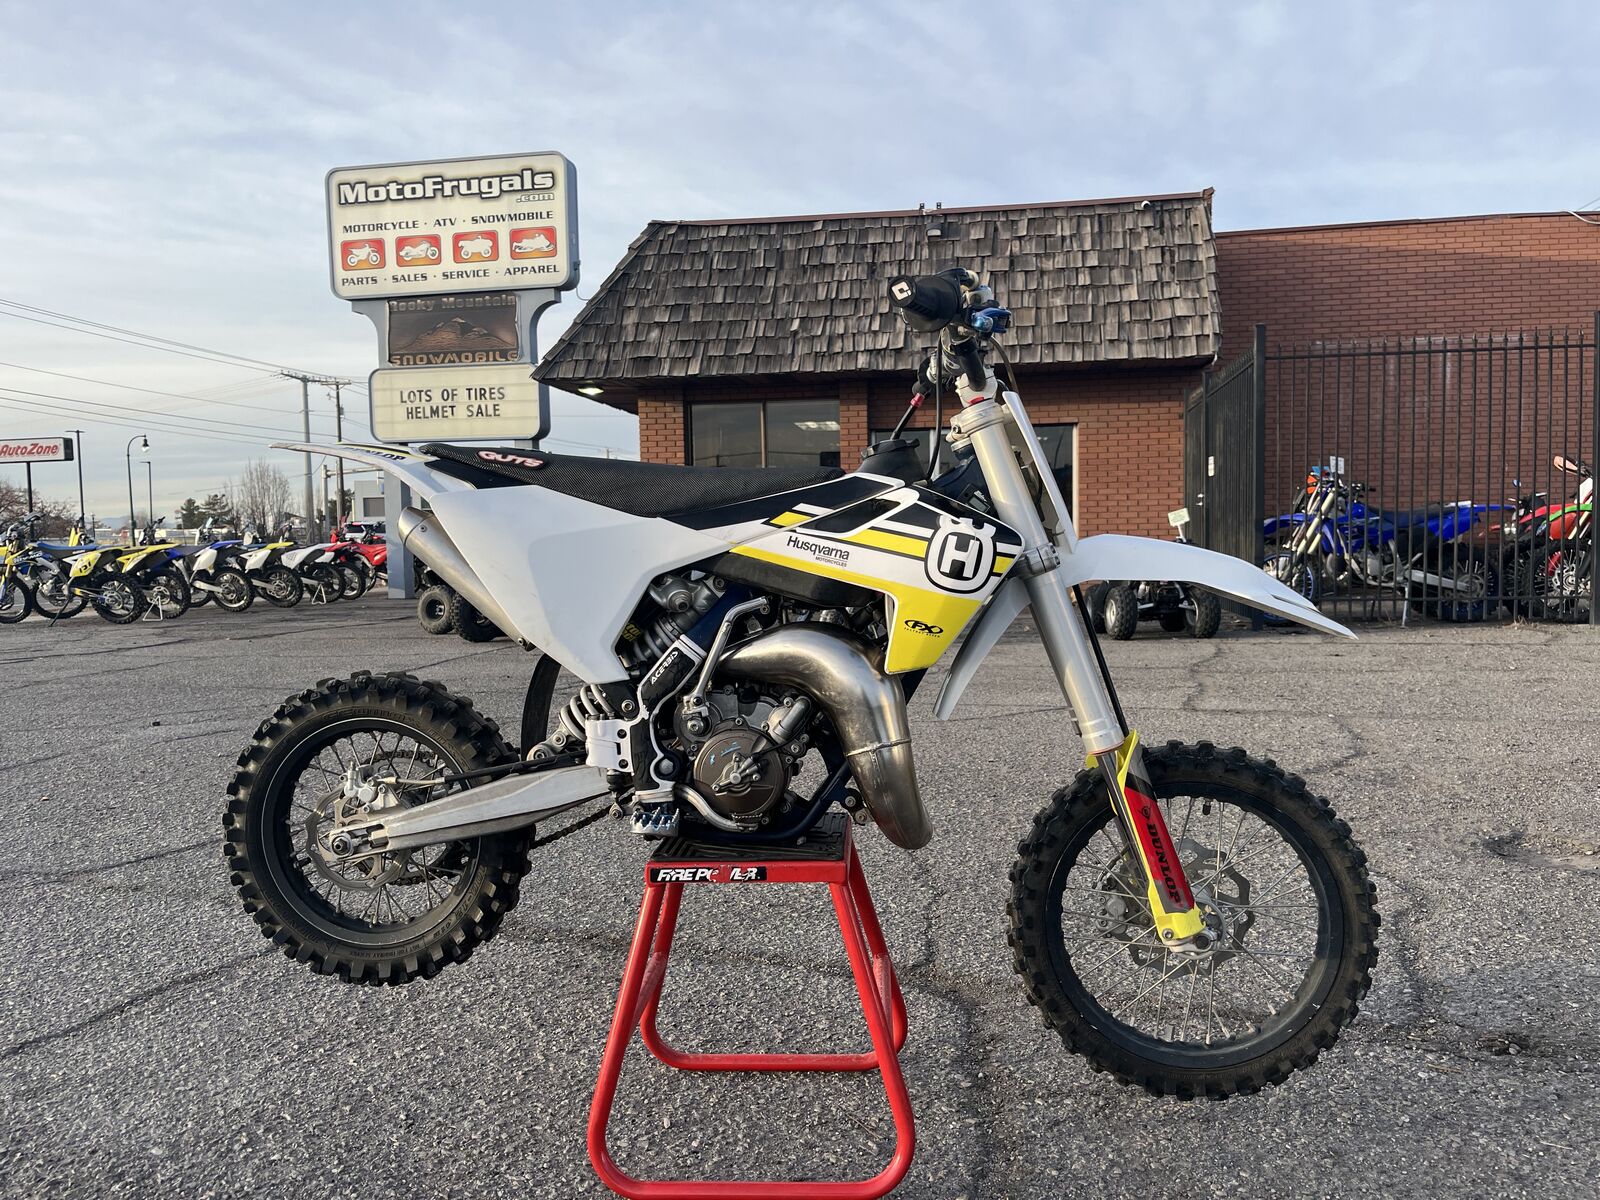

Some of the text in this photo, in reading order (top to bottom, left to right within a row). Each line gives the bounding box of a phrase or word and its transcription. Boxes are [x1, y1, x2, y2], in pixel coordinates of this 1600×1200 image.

[338, 168, 555, 205] MotoFrugals
[517, 192, 555, 203] .com
[342, 210, 554, 234] MOTORCYCLE ATV SNOWMOBILE
[341, 264, 560, 287] PARTS SALES SERVICE APPAREL
[389, 294, 516, 312] Rocky Mountain
[391, 350, 518, 367] SNOWMOBILE
[400, 386, 505, 404] LOTS OF TIRES
[406, 403, 500, 420] HELMET SALE
[0, 443, 59, 457] AutoZone
[478, 450, 544, 467] GUTS
[786, 535, 850, 561] Husqvarna
[815, 556, 848, 568] MOTORCYCLES
[651, 651, 678, 685] ACERBIS
[1147, 823, 1182, 904] DUNLOP
